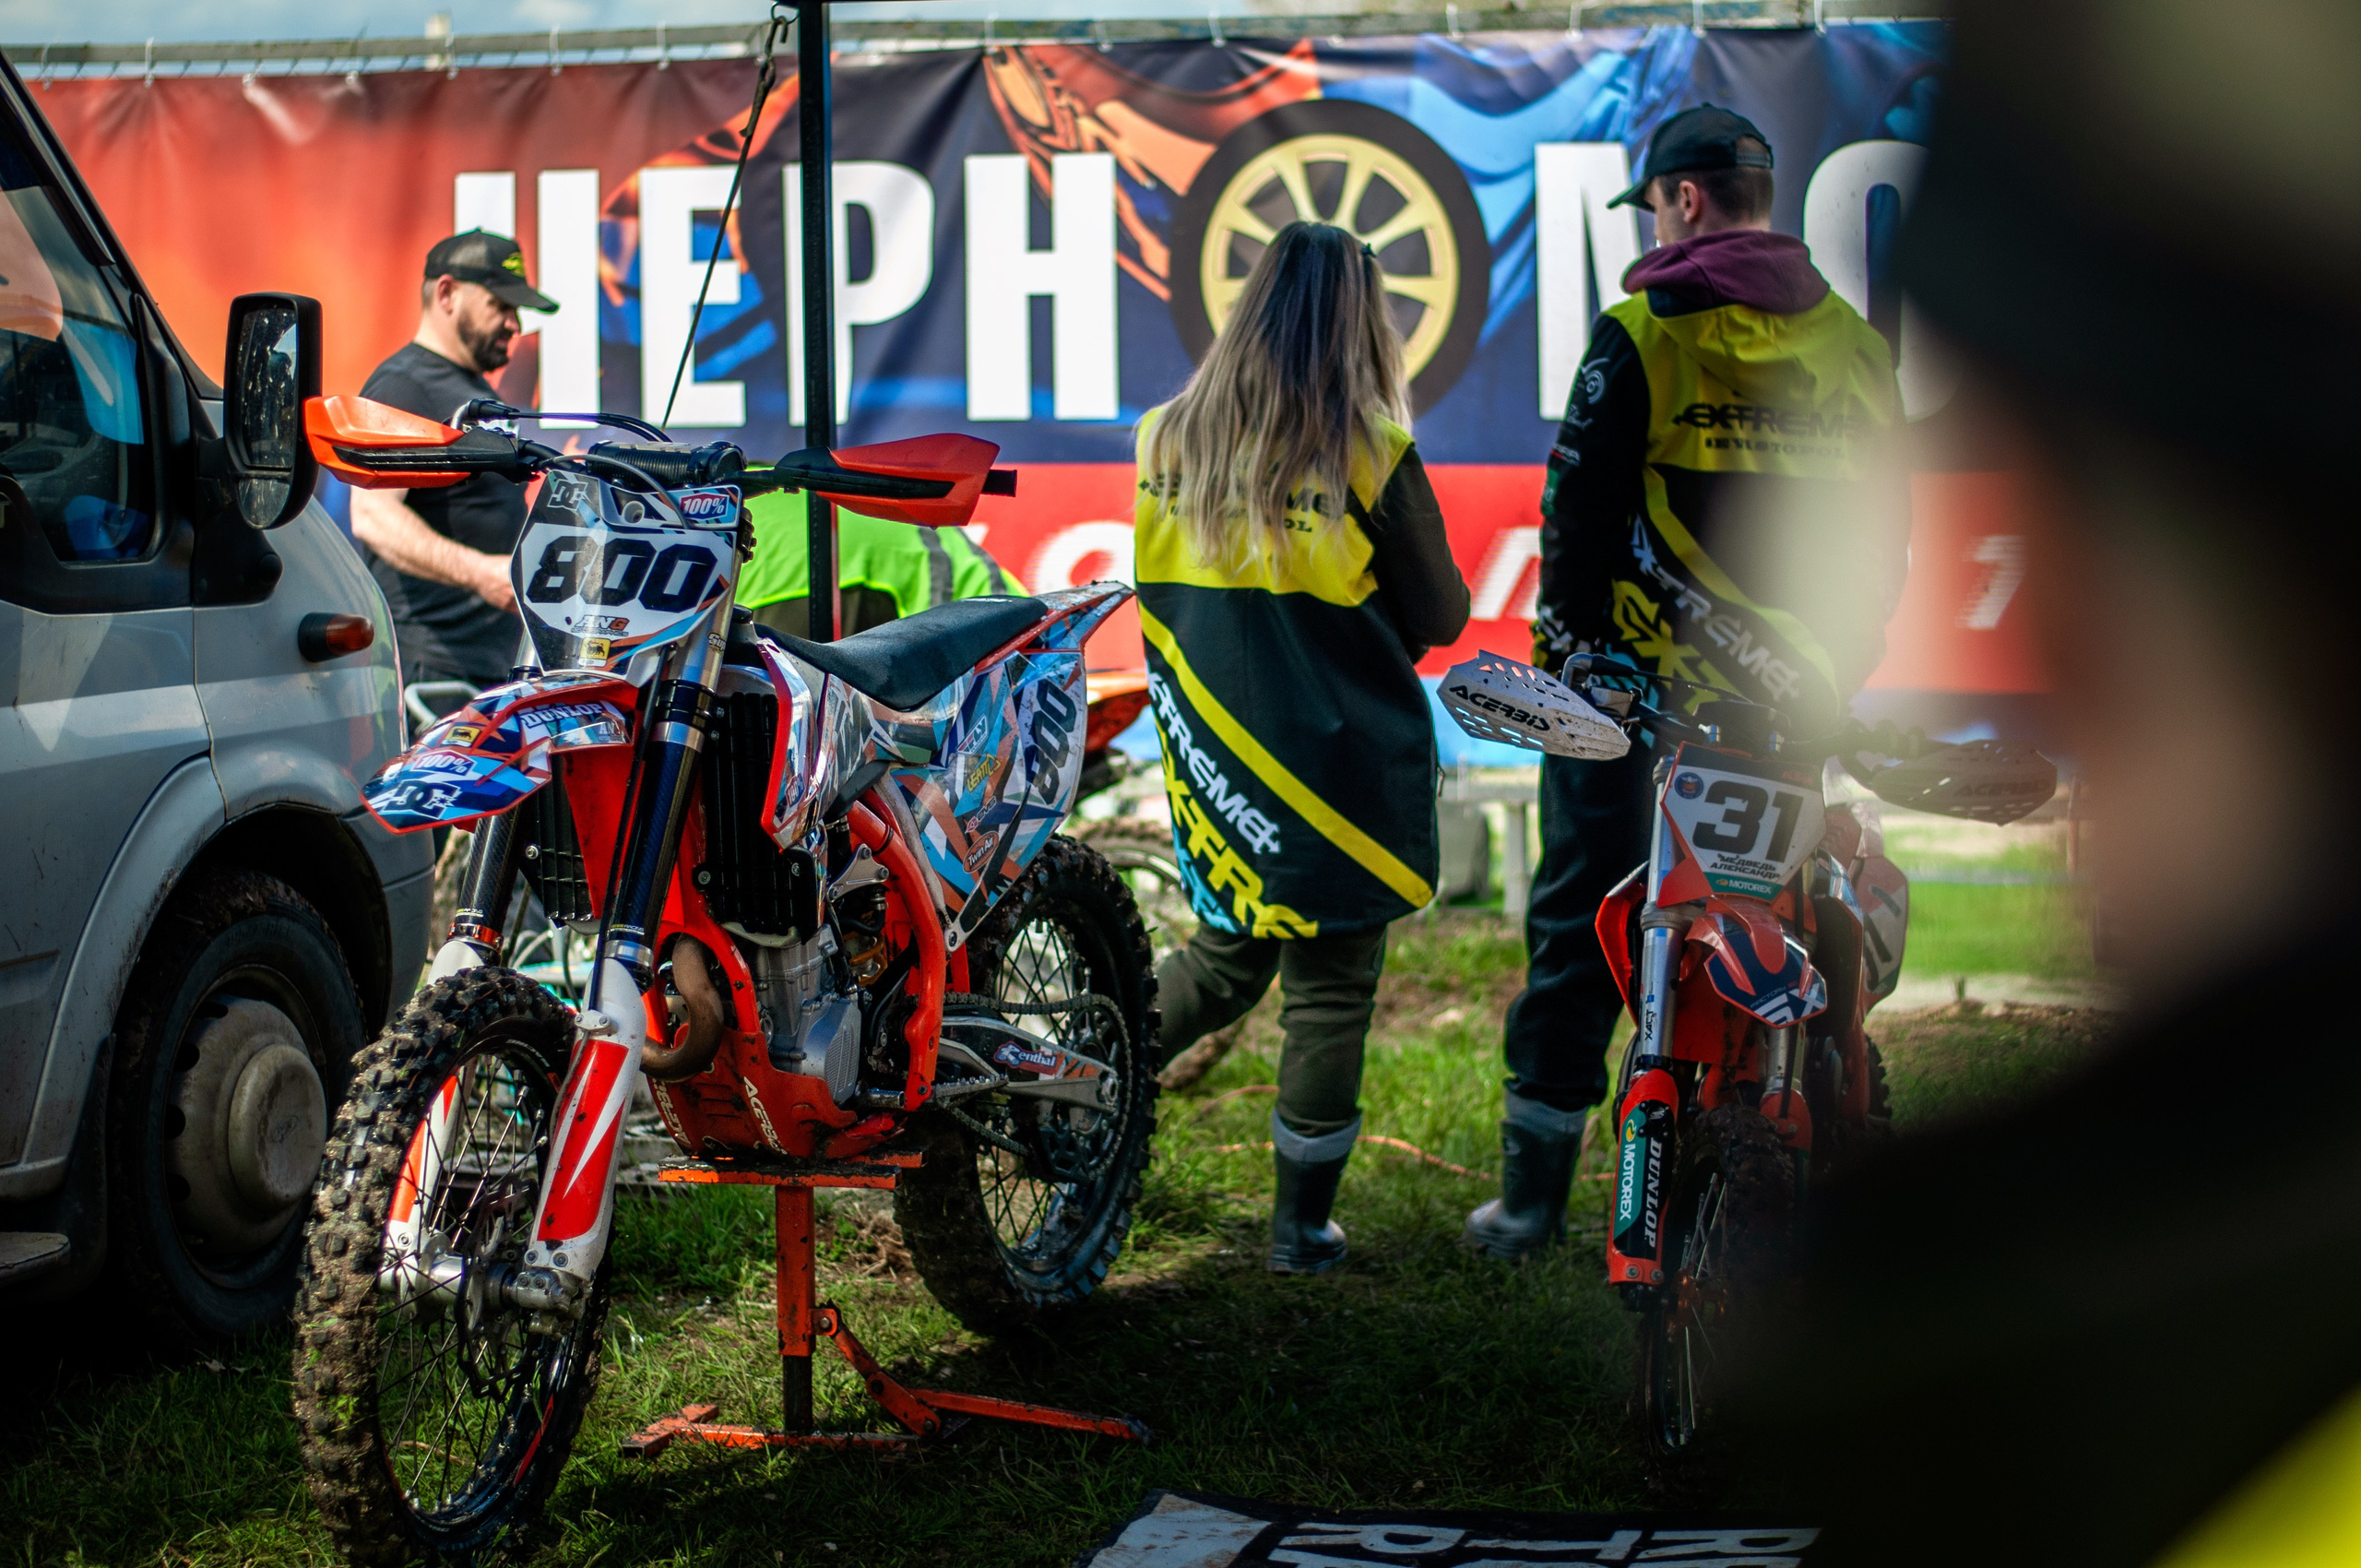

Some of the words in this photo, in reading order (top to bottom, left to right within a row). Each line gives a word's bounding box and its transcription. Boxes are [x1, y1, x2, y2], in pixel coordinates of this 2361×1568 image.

[548, 480, 588, 510] DC
[682, 498, 727, 517] 100%
[527, 535, 718, 613] 800
[574, 614, 630, 631] ANG
[520, 703, 604, 729] DUNLOP
[1026, 679, 1079, 805] 800
[417, 754, 469, 774] 100%
[1692, 780, 1804, 862] 31
[1729, 880, 1772, 894] MOTOREX
[1644, 1009, 1654, 1041] XACT
[1619, 1144, 1636, 1221] MOTOREX
[1643, 1137, 1662, 1248] DUNLOP
